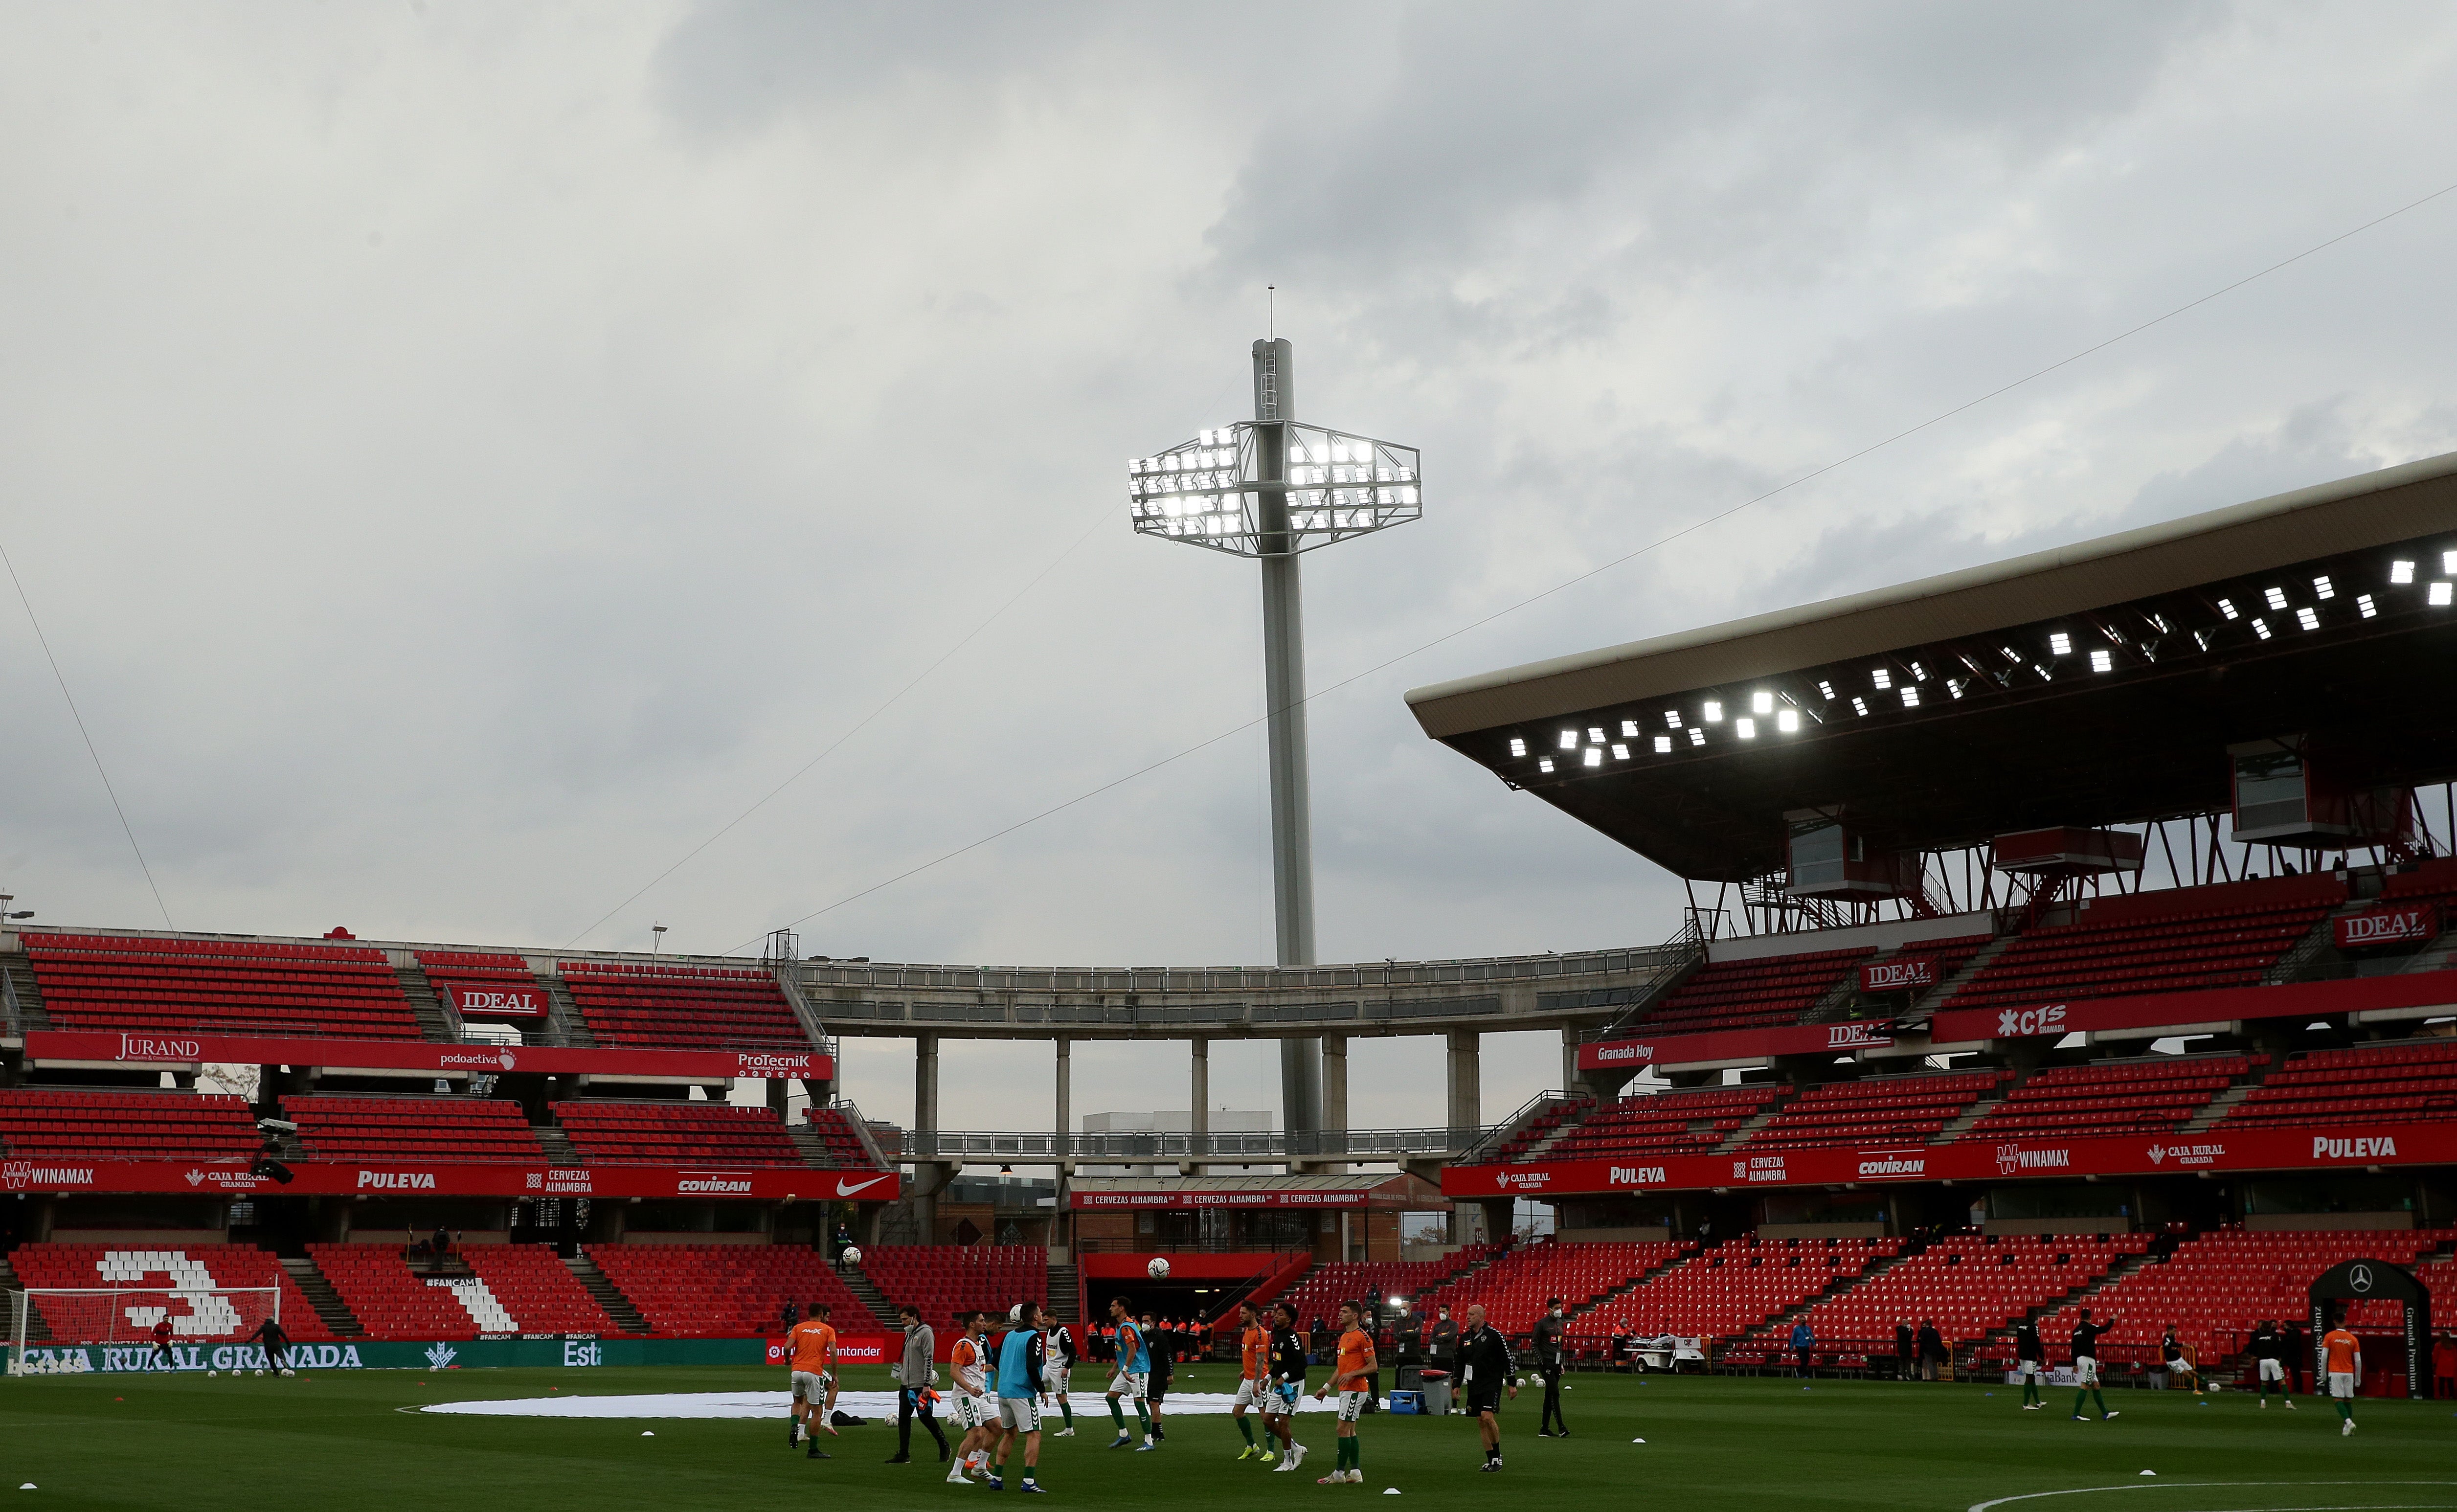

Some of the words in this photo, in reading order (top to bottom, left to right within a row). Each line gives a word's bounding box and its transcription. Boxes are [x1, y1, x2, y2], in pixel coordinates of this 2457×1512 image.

[2345, 912, 2426, 939] IDEAL
[1869, 963, 1931, 984] IDEAL
[463, 992, 537, 1010] IDEAL
[2020, 1005, 2066, 1035] CTS
[2039, 1024, 2065, 1034] GRANADA
[115, 1033, 200, 1061] JURAND
[1598, 1045, 1634, 1060] Granada
[1636, 1044, 1653, 1060] Hoy
[441, 1054, 497, 1066] podoactiva
[739, 1054, 810, 1067] ProTecniK
[2168, 1146, 2190, 1156] CAJA
[2192, 1145, 2225, 1155] RURAL
[2314, 1137, 2396, 1158] PULEVA
[1751, 1156, 1784, 1168] CERVEZAS
[2019, 1150, 2069, 1168] WINAMAX
[32, 1168, 93, 1184] WINAMAX
[208, 1172, 232, 1181] CAJA
[358, 1171, 435, 1188] PULEVA
[549, 1170, 589, 1180] CERVEZAS
[1528, 1173, 1551, 1181] RURAL
[1610, 1167, 1666, 1184] PULEVA
[1749, 1170, 1786, 1181] ALHAMBRA
[545, 1182, 592, 1193] ALHAMBRA
[1229, 1195, 1266, 1203] ALHAMBRA
[1323, 1194, 1358, 1202] ALHAMBRA
[1475, 1231, 1482, 1241] 15
[427, 1279, 474, 1287] #FANCAM
[2407, 1307, 2415, 1346] Granada
[7, 1358, 85, 1375] bet365
[102, 1346, 207, 1371] RURAL
[2409, 1349, 2417, 1390] Premium
